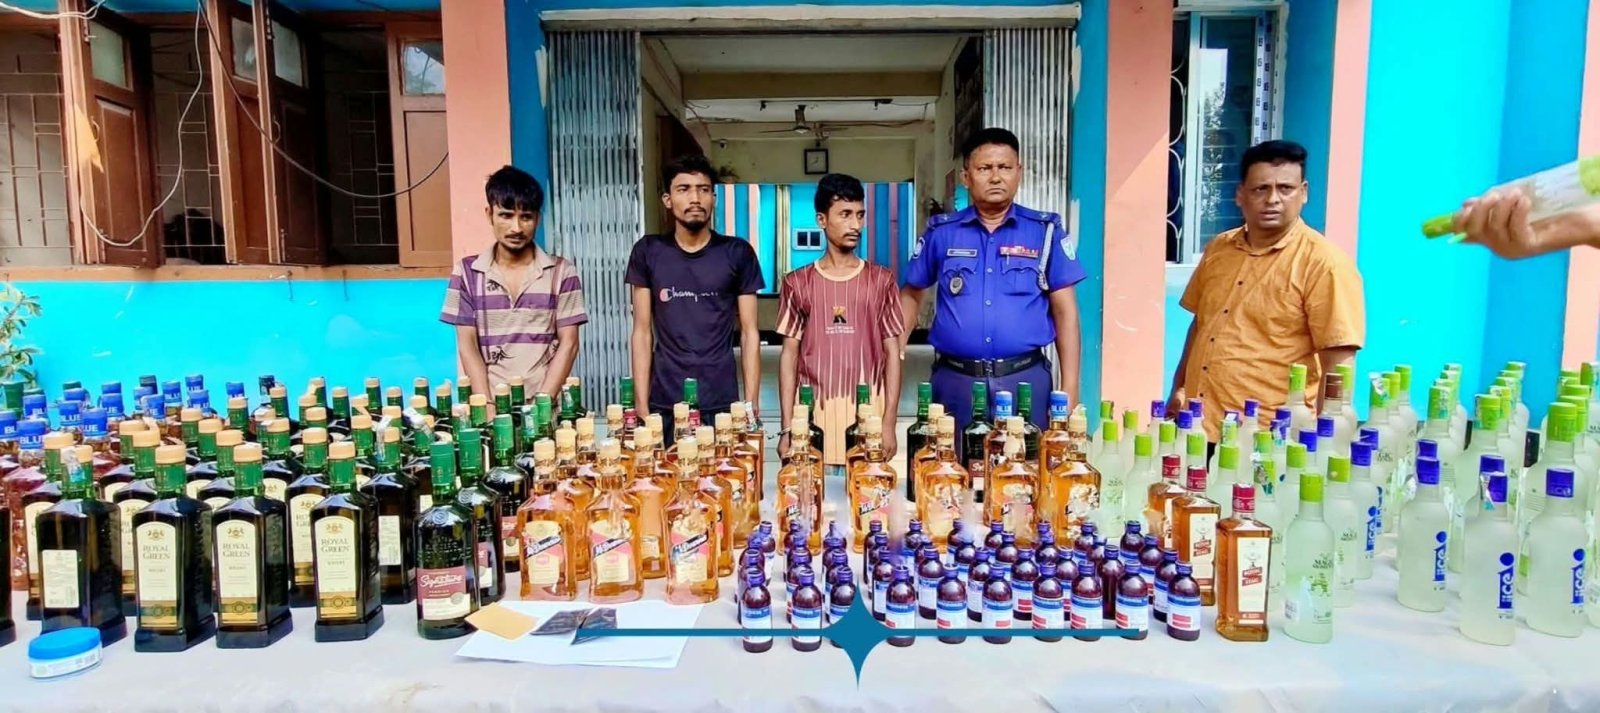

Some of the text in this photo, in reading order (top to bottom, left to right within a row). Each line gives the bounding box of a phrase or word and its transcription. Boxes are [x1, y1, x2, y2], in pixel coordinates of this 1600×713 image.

[222, 542, 250, 550] ROYAL
[321, 545, 349, 553] GREEN
[142, 552, 170, 560] GREEN
[222, 550, 250, 558] GREEN
